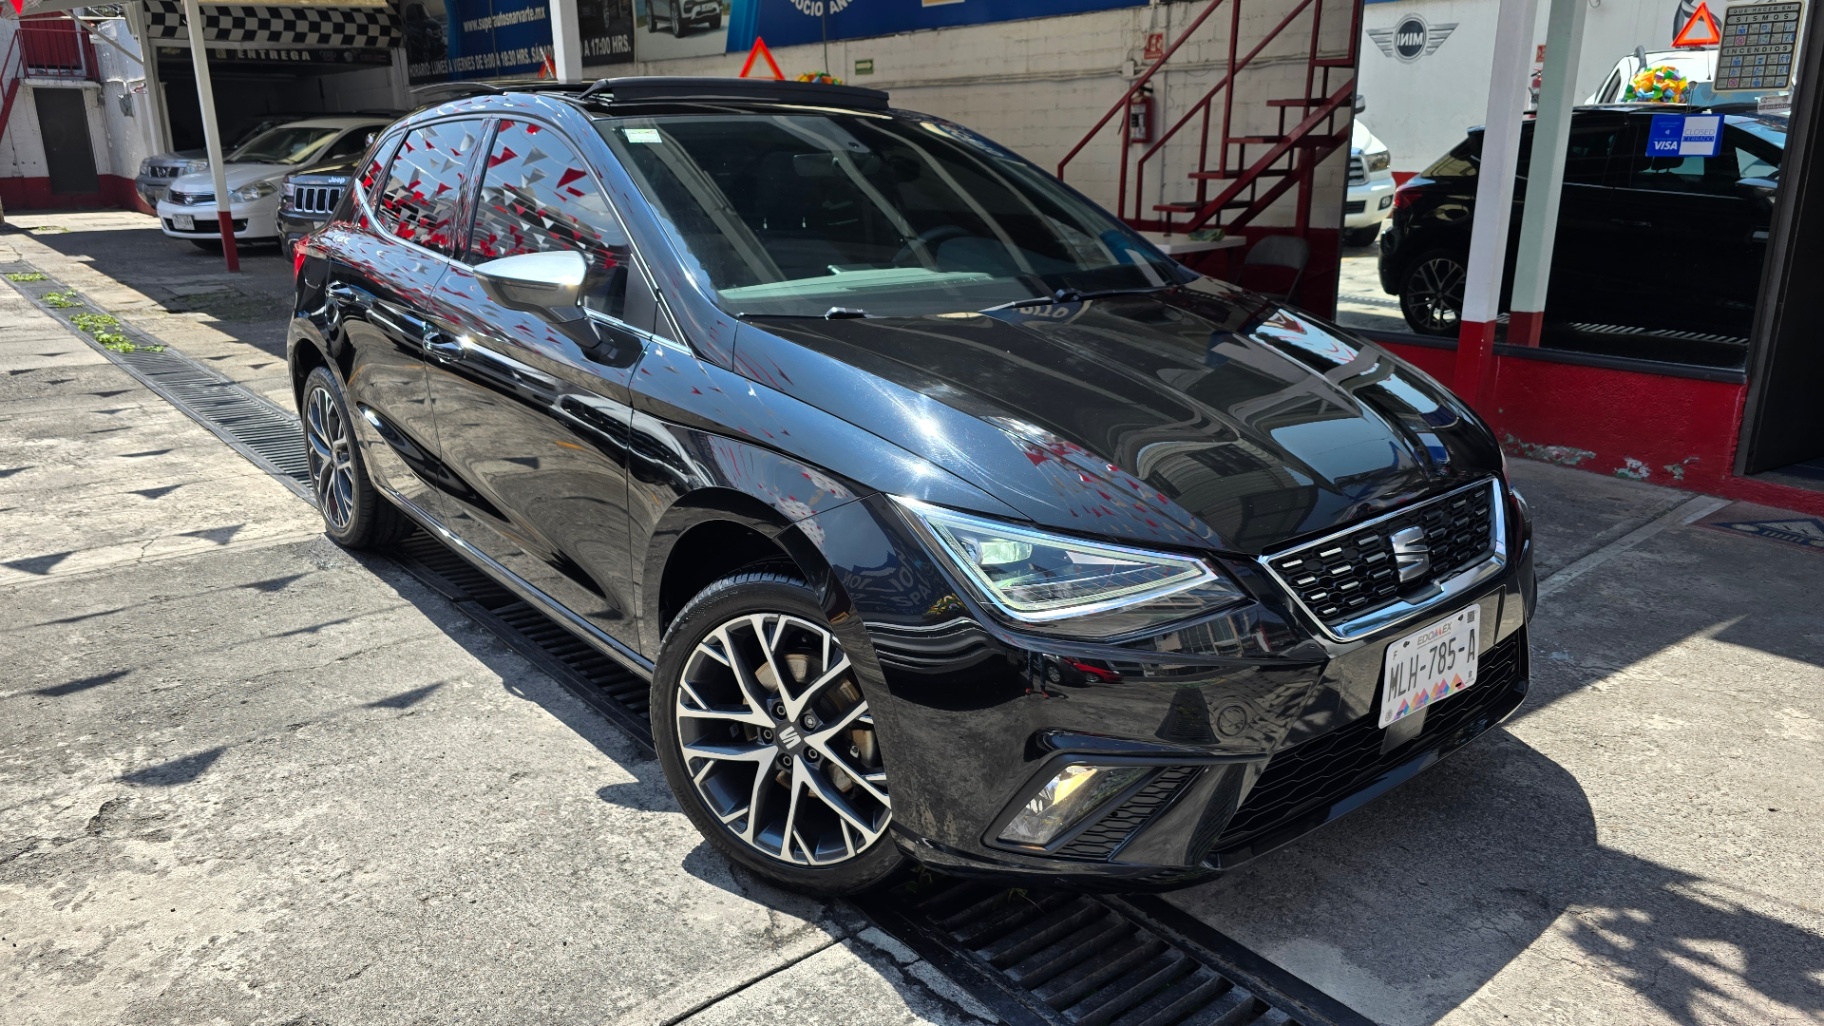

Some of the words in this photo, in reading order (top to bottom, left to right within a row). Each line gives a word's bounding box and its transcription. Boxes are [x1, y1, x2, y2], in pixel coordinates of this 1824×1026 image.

[790, 0, 823, 16] OCIO
[829, 0, 853, 14] AN
[1735, 13, 1789, 23] SISMOS
[431, 60, 448, 74] LUNES
[448, 59, 453, 73] A
[453, 56, 475, 72] VIERNES
[475, 54, 484, 70] DE
[531, 42, 555, 63] SÁBAD
[584, 40, 590, 57] A
[591, 36, 611, 56] 17:00
[612, 34, 631, 54] HRS.
[1726, 45, 1788, 54] INCENDIOS
[237, 49, 311, 61] ENTREGA
[1684, 128, 1716, 136] CLOSED
[1653, 141, 1678, 150] VISA
[328, 176, 345, 184] Jeep
[1387, 628, 1475, 703] MLH-785-A
